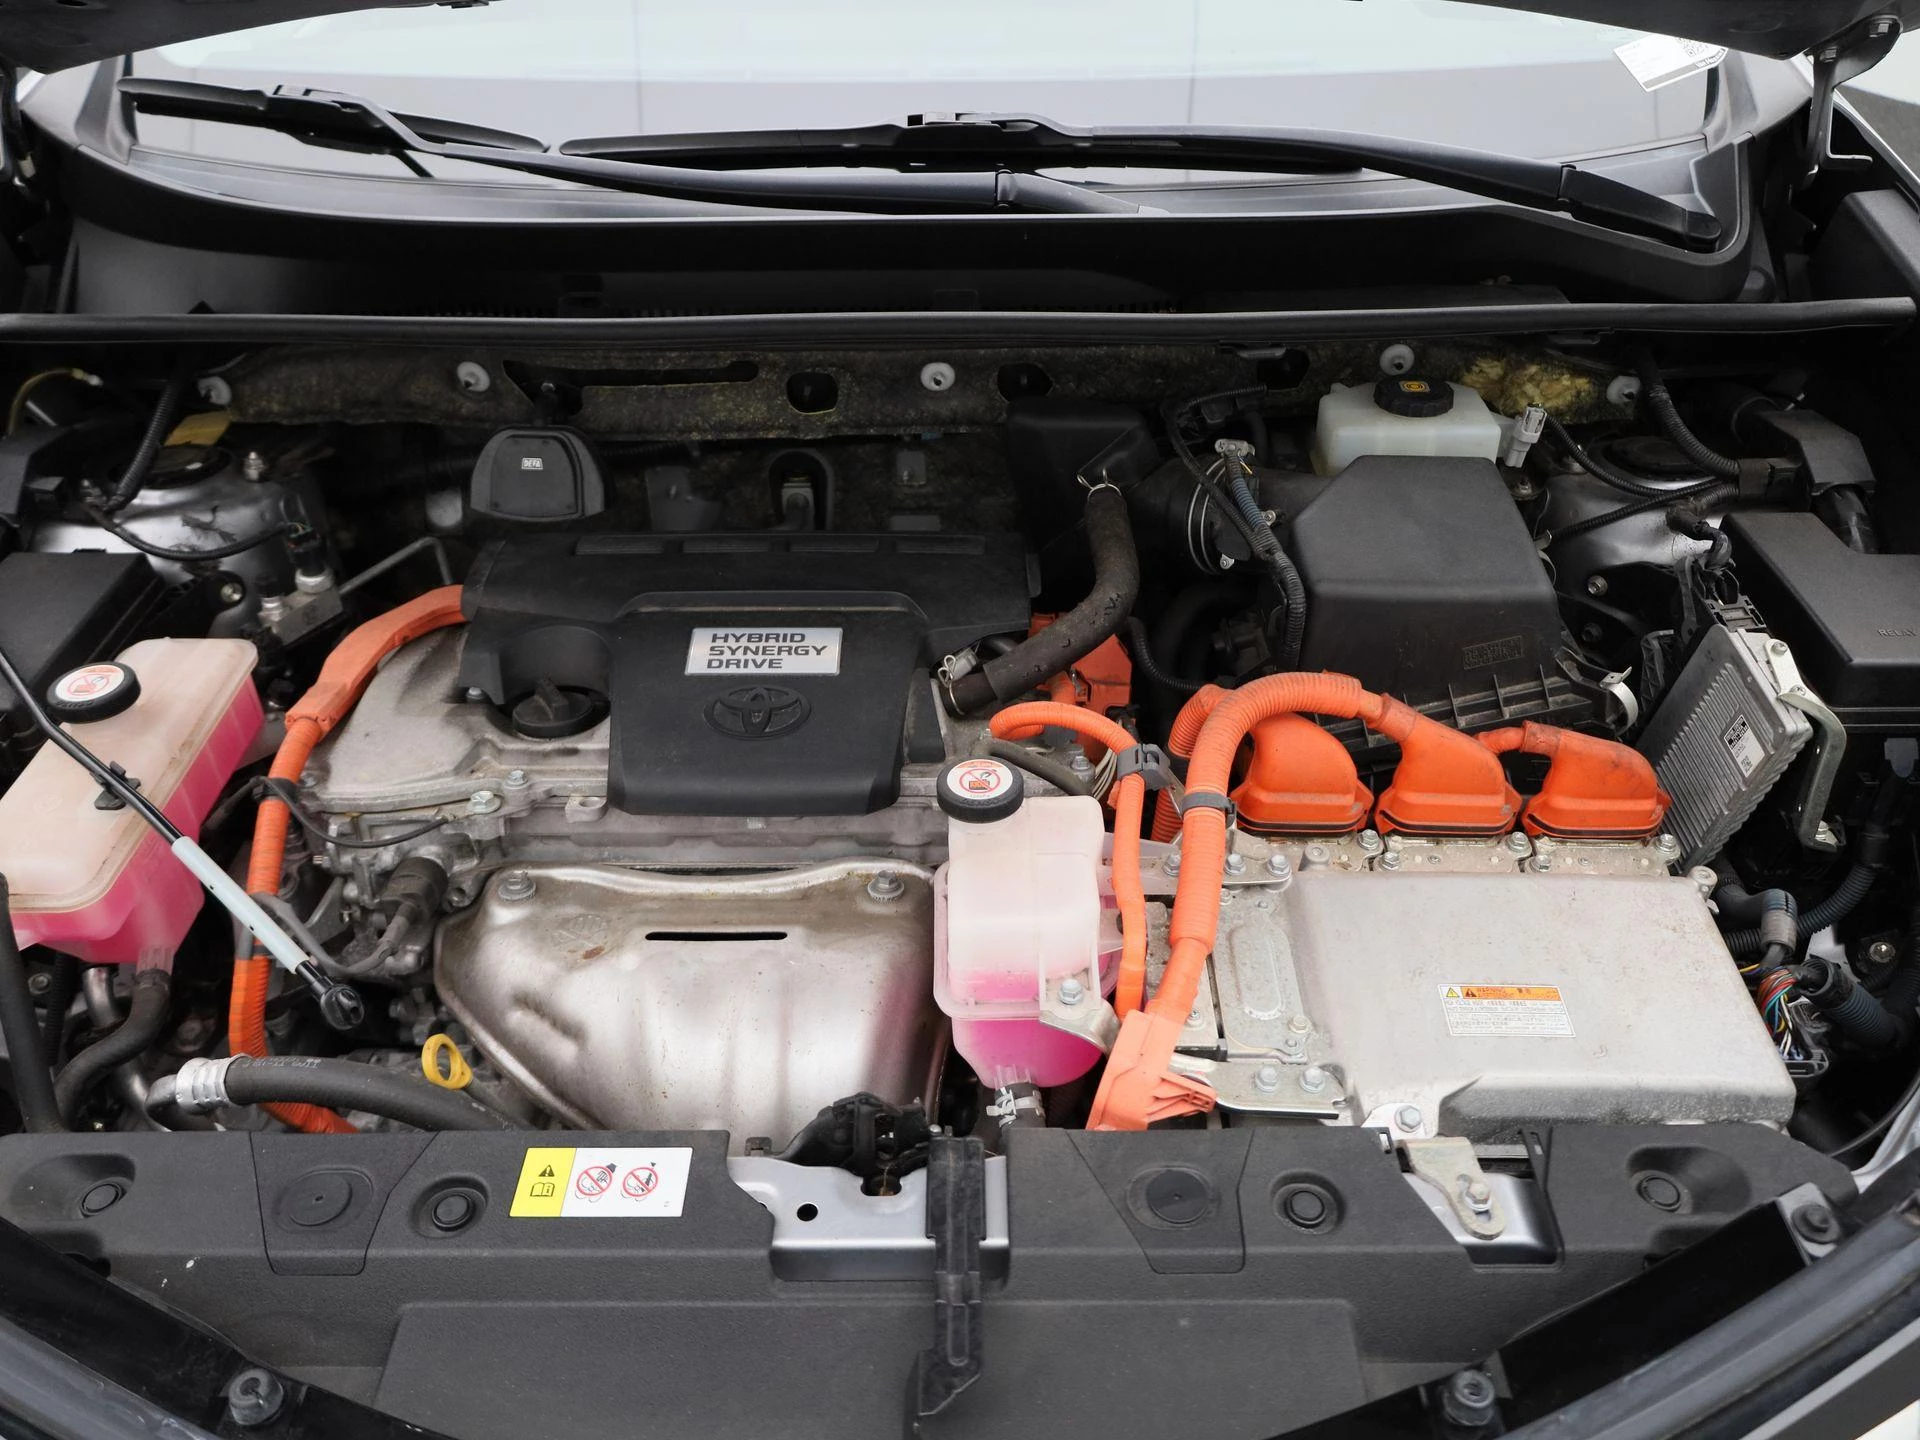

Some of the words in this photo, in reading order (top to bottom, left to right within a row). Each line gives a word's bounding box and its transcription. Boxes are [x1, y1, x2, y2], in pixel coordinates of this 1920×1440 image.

[711, 633, 806, 643] HYBRID
[709, 645, 828, 656] SYNERGY
[707, 658, 783, 669] DRIVE
